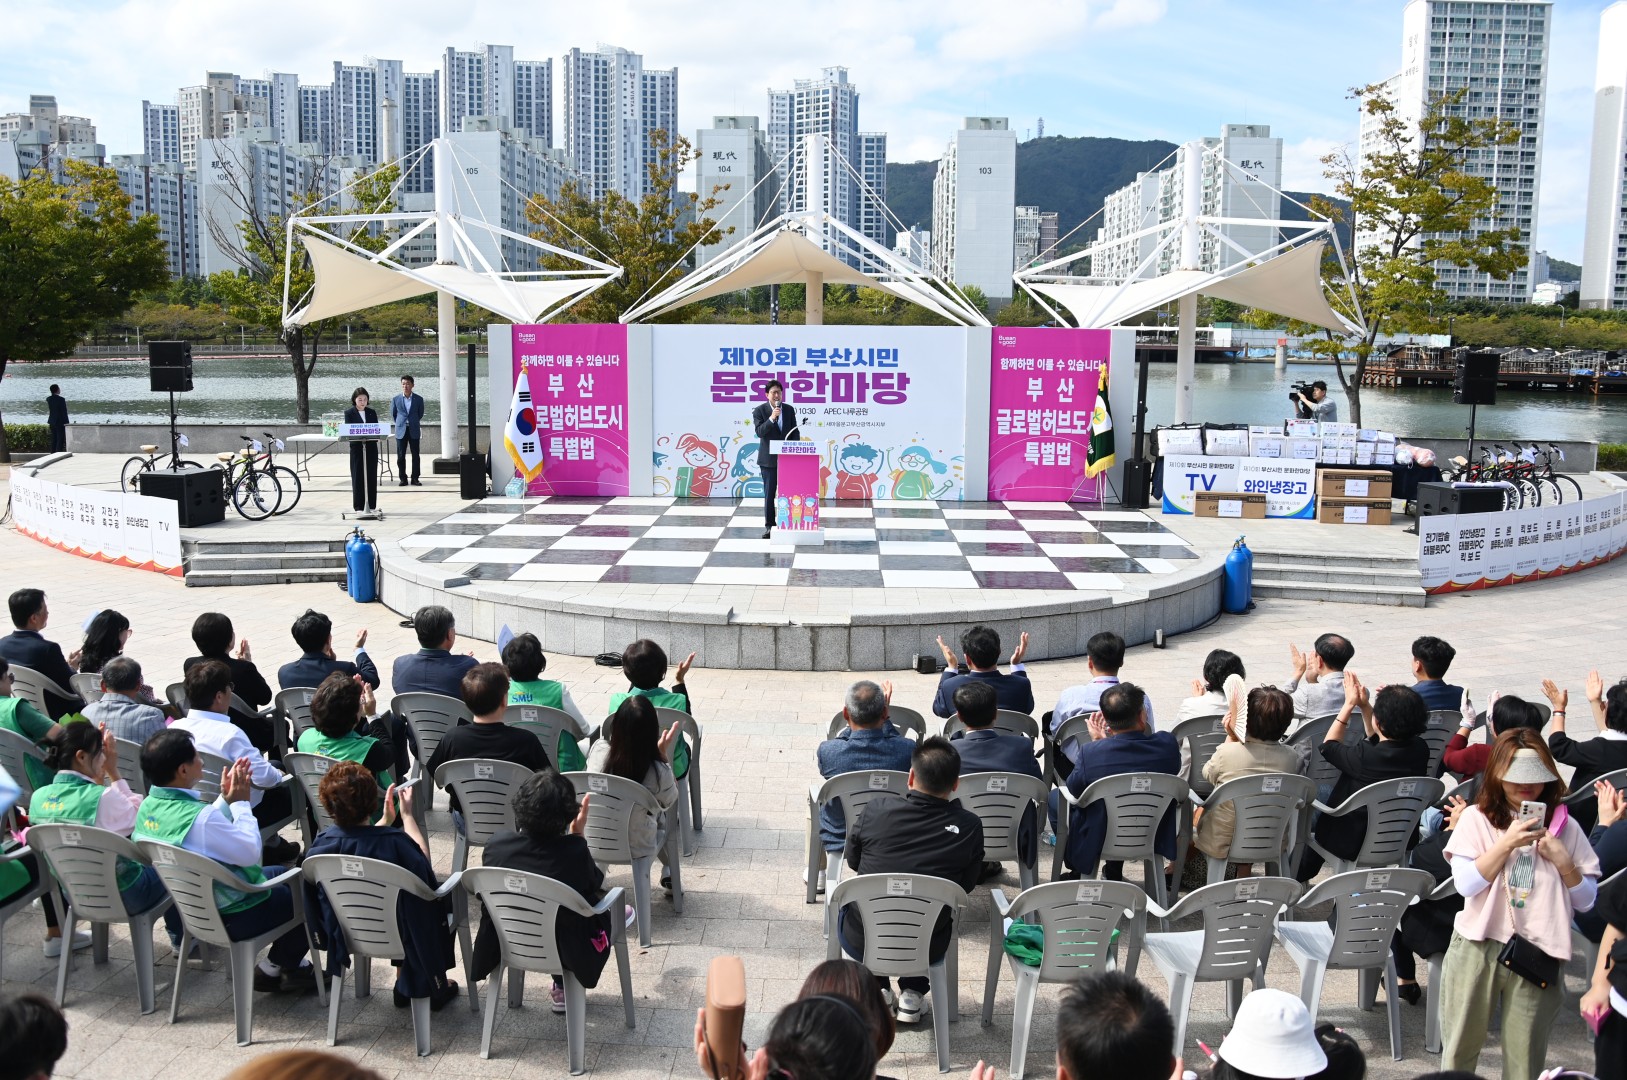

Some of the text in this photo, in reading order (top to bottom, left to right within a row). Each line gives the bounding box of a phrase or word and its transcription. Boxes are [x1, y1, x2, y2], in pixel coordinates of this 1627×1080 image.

[712, 151, 738, 160] 現代
[718, 165, 732, 173] 104
[1240, 160, 1265, 169] 現代
[217, 173, 229, 181] 106
[466, 167, 479, 175] 105
[979, 167, 992, 175] 103
[575, 355, 584, 367] 수
[586, 354, 620, 368] 있습니다
[719, 346, 899, 368] 제10회 부산시민
[1000, 357, 1035, 370] 함께하면
[1056, 359, 1066, 371] 수
[1067, 359, 1102, 372] 있습니다
[710, 370, 911, 405] 문화한마당
[536, 404, 624, 431] 로벌허브도시
[823, 407, 842, 415] APEC
[842, 407, 869, 416] 나루공원
[549, 436, 595, 461] 특별법
[781, 446, 817, 454] 문화한마당
[1024, 441, 1071, 467] 특별법
[1187, 462, 1208, 470] 부산시민
[1208, 462, 1235, 471] 문화한마당
[1185, 473, 1217, 493] TV
[1243, 479, 1308, 495] 와인냉장고
[80, 502, 95, 514] 자전거
[101, 506, 119, 518] 자전거
[1459, 527, 1486, 540] 와인냉장고
[1423, 543, 1451, 556] 태블릿PC
[1458, 540, 1485, 551] 태블릿PC
